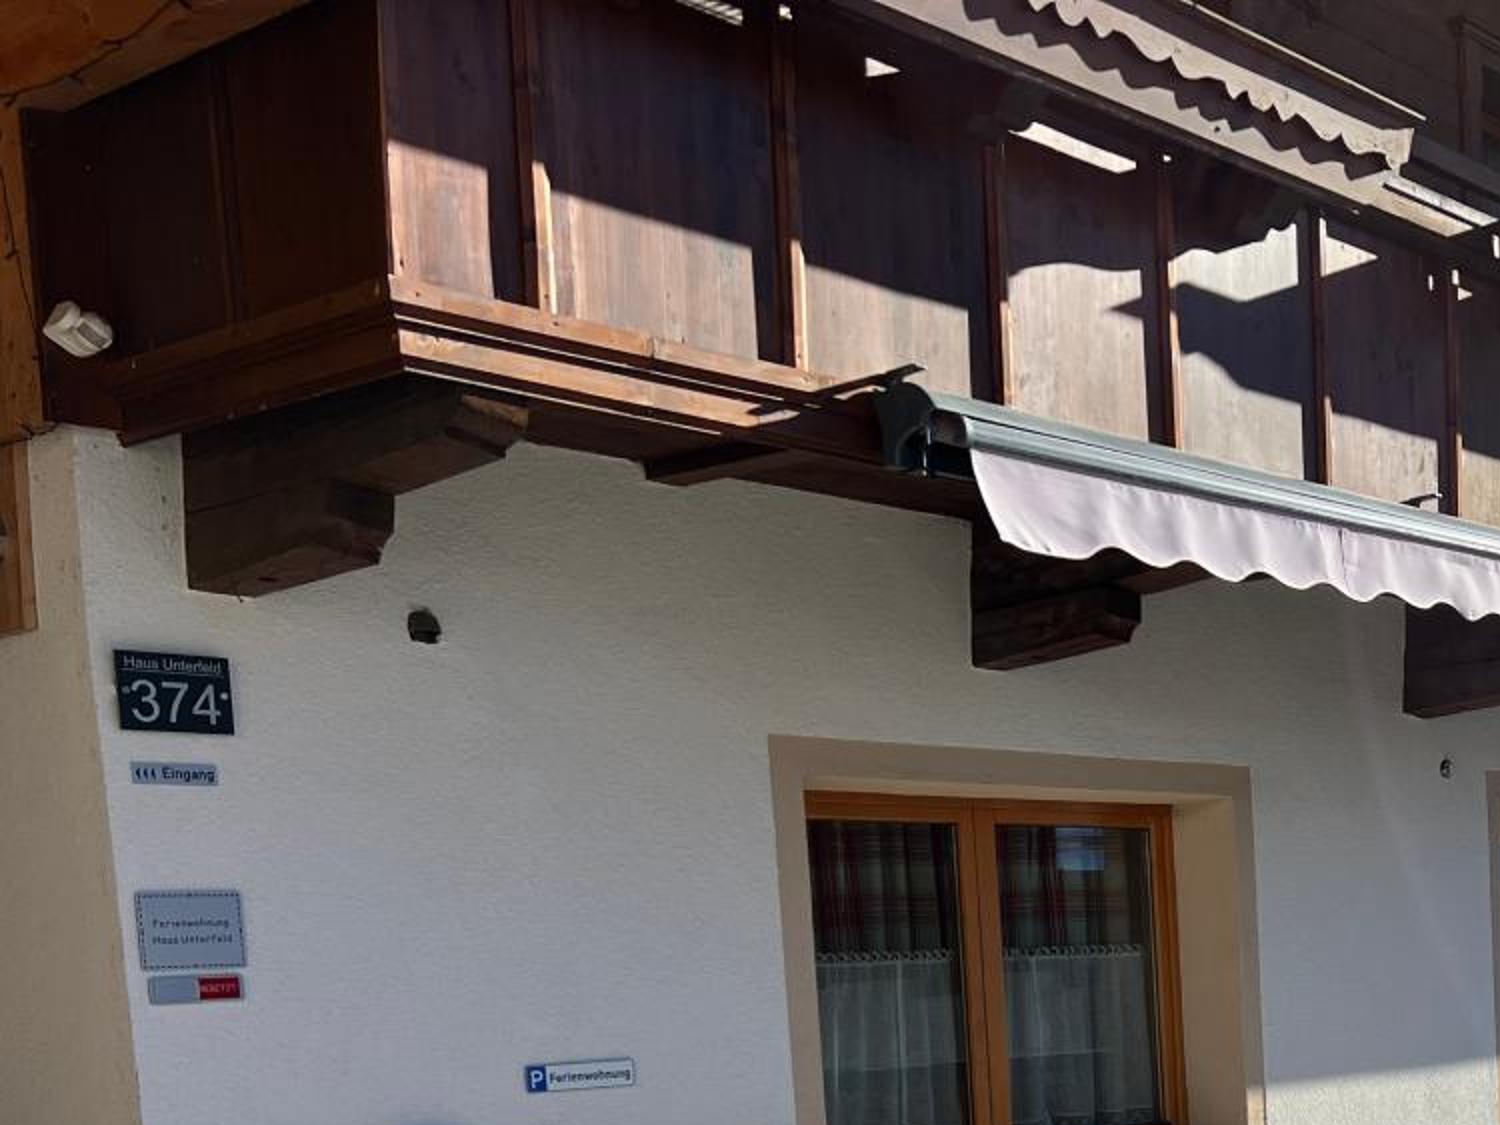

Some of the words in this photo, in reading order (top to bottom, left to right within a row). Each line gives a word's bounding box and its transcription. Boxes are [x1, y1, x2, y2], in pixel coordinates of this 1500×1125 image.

[123, 656, 158, 669] Haus
[163, 658, 221, 673] Unterfeld
[131, 679, 221, 725] 374
[162, 766, 215, 782] Eingang
[530, 1070, 543, 1088] P
[549, 1069, 630, 1084] Ferienwohnung
